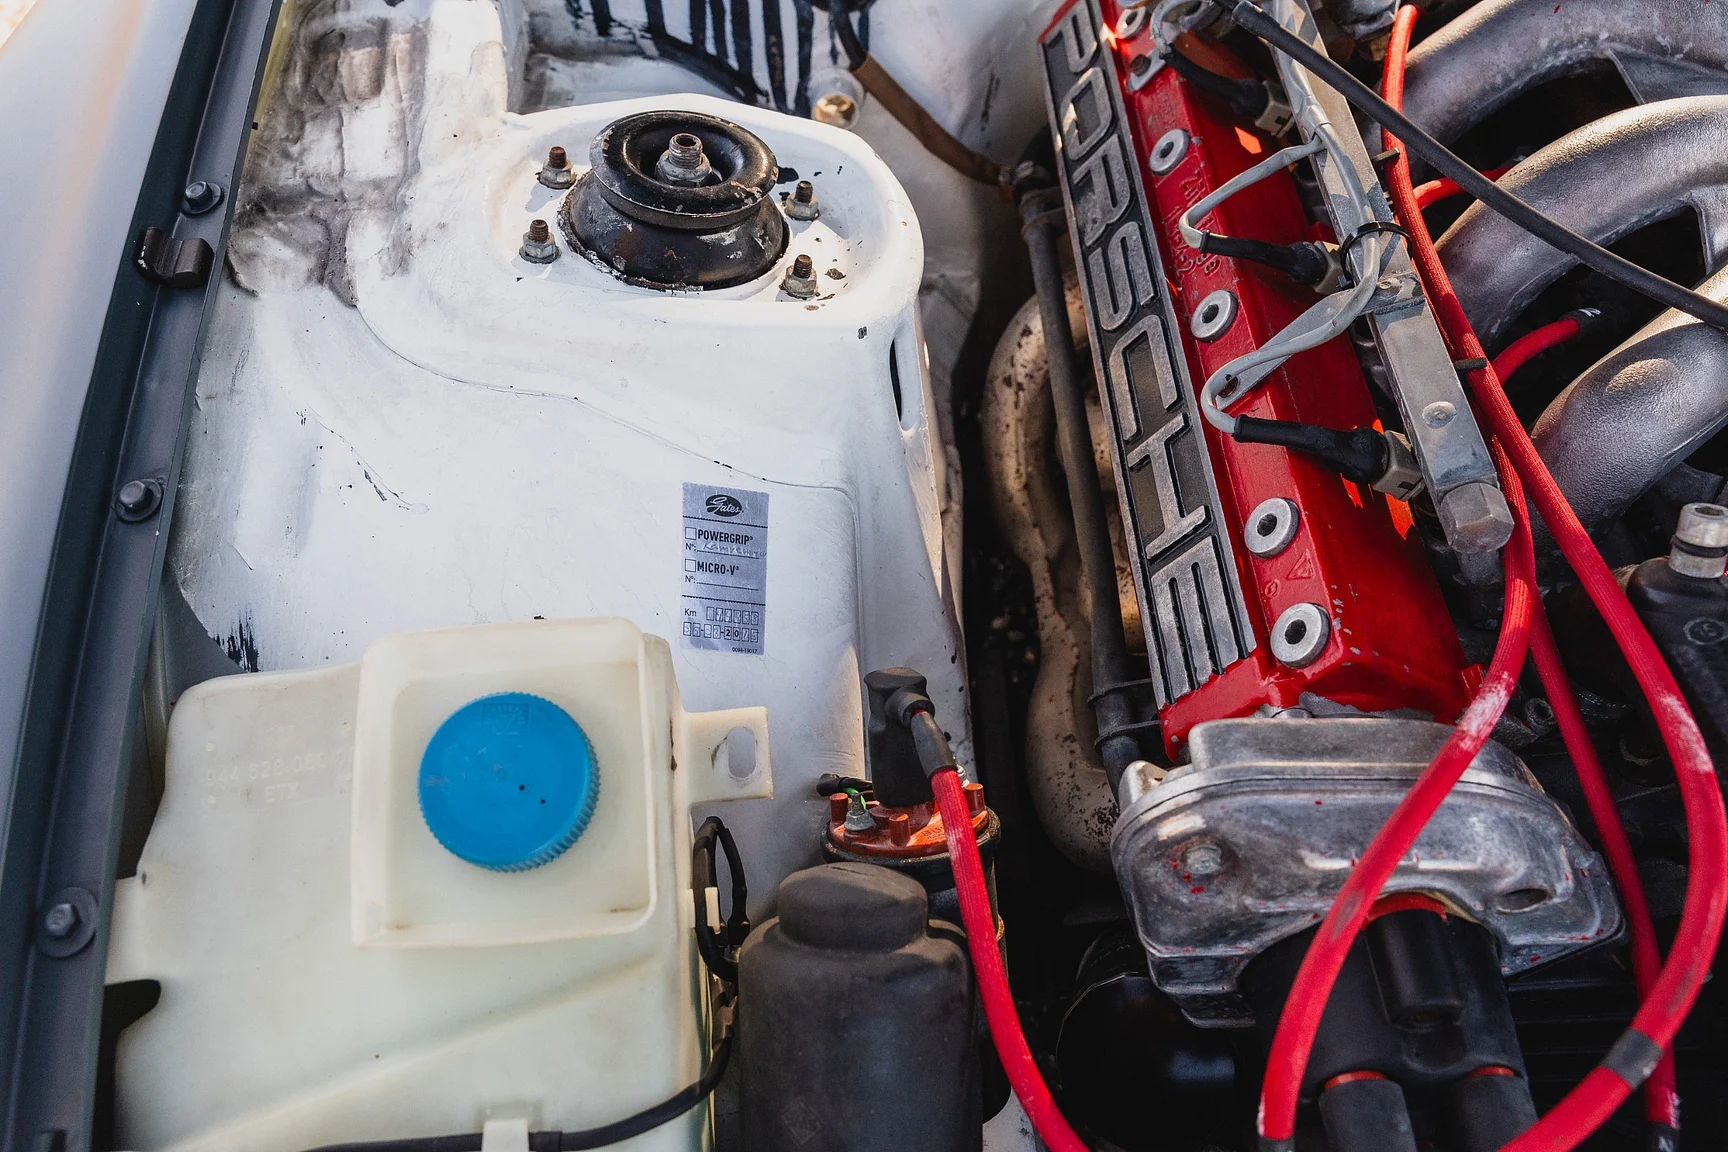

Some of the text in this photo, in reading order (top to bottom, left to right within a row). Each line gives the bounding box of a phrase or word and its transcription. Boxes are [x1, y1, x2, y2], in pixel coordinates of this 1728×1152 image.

[1049, 2, 1256, 698] PORSCHE
[706, 496, 742, 514] Gates
[684, 608, 697, 617] Km
